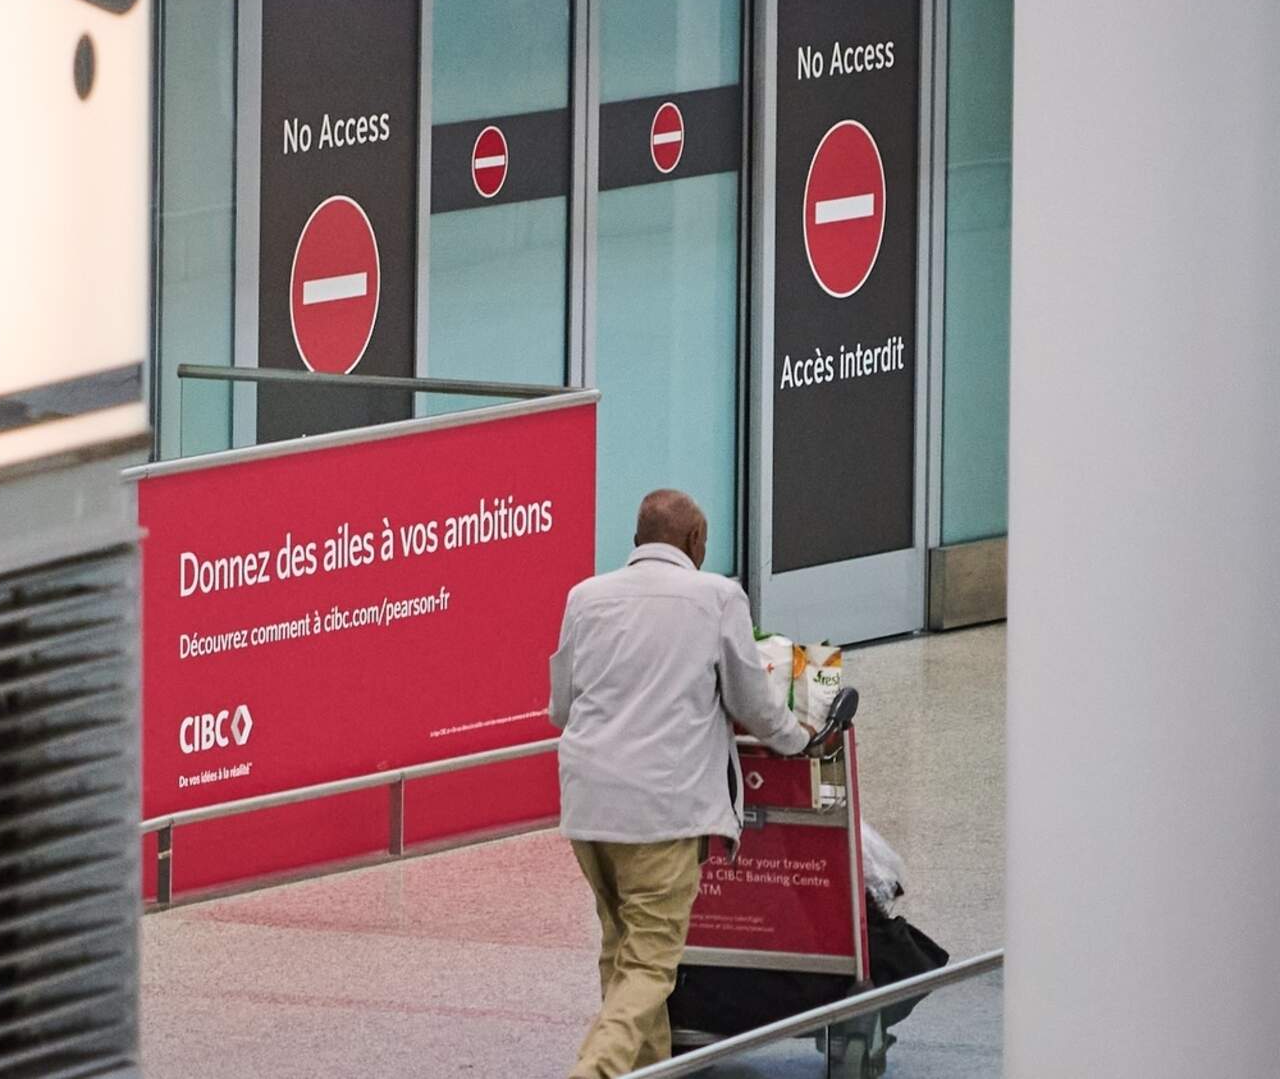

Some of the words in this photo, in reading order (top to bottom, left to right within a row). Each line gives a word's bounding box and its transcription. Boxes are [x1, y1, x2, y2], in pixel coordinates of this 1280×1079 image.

[797, 45, 823, 80] No
[830, 40, 894, 74] Access
[283, 119, 311, 154] No
[319, 112, 389, 150] Access
[781, 347, 834, 389] Accès
[839, 336, 904, 381] interdit
[180, 552, 269, 597] Donnez
[276, 533, 316, 580] des
[323, 522, 373, 571] ailes
[381, 517, 394, 560] à
[400, 520, 438, 557] vos
[444, 496, 552, 549] ambitions
[180, 626, 248, 659] Découvrez
[251, 617, 310, 648] comment
[314, 610, 321, 633] à
[324, 586, 450, 632] cibc.com/pearson-fr
[180, 710, 229, 754] CIBC
[707, 872, 714, 880] a
[716, 870, 744, 882] CIBC
[746, 871, 790, 887] Banking
[792, 875, 830, 888] Centre
[738, 856, 753, 867] for
[756, 858, 780, 870] your
[783, 858, 827, 871] travels?
